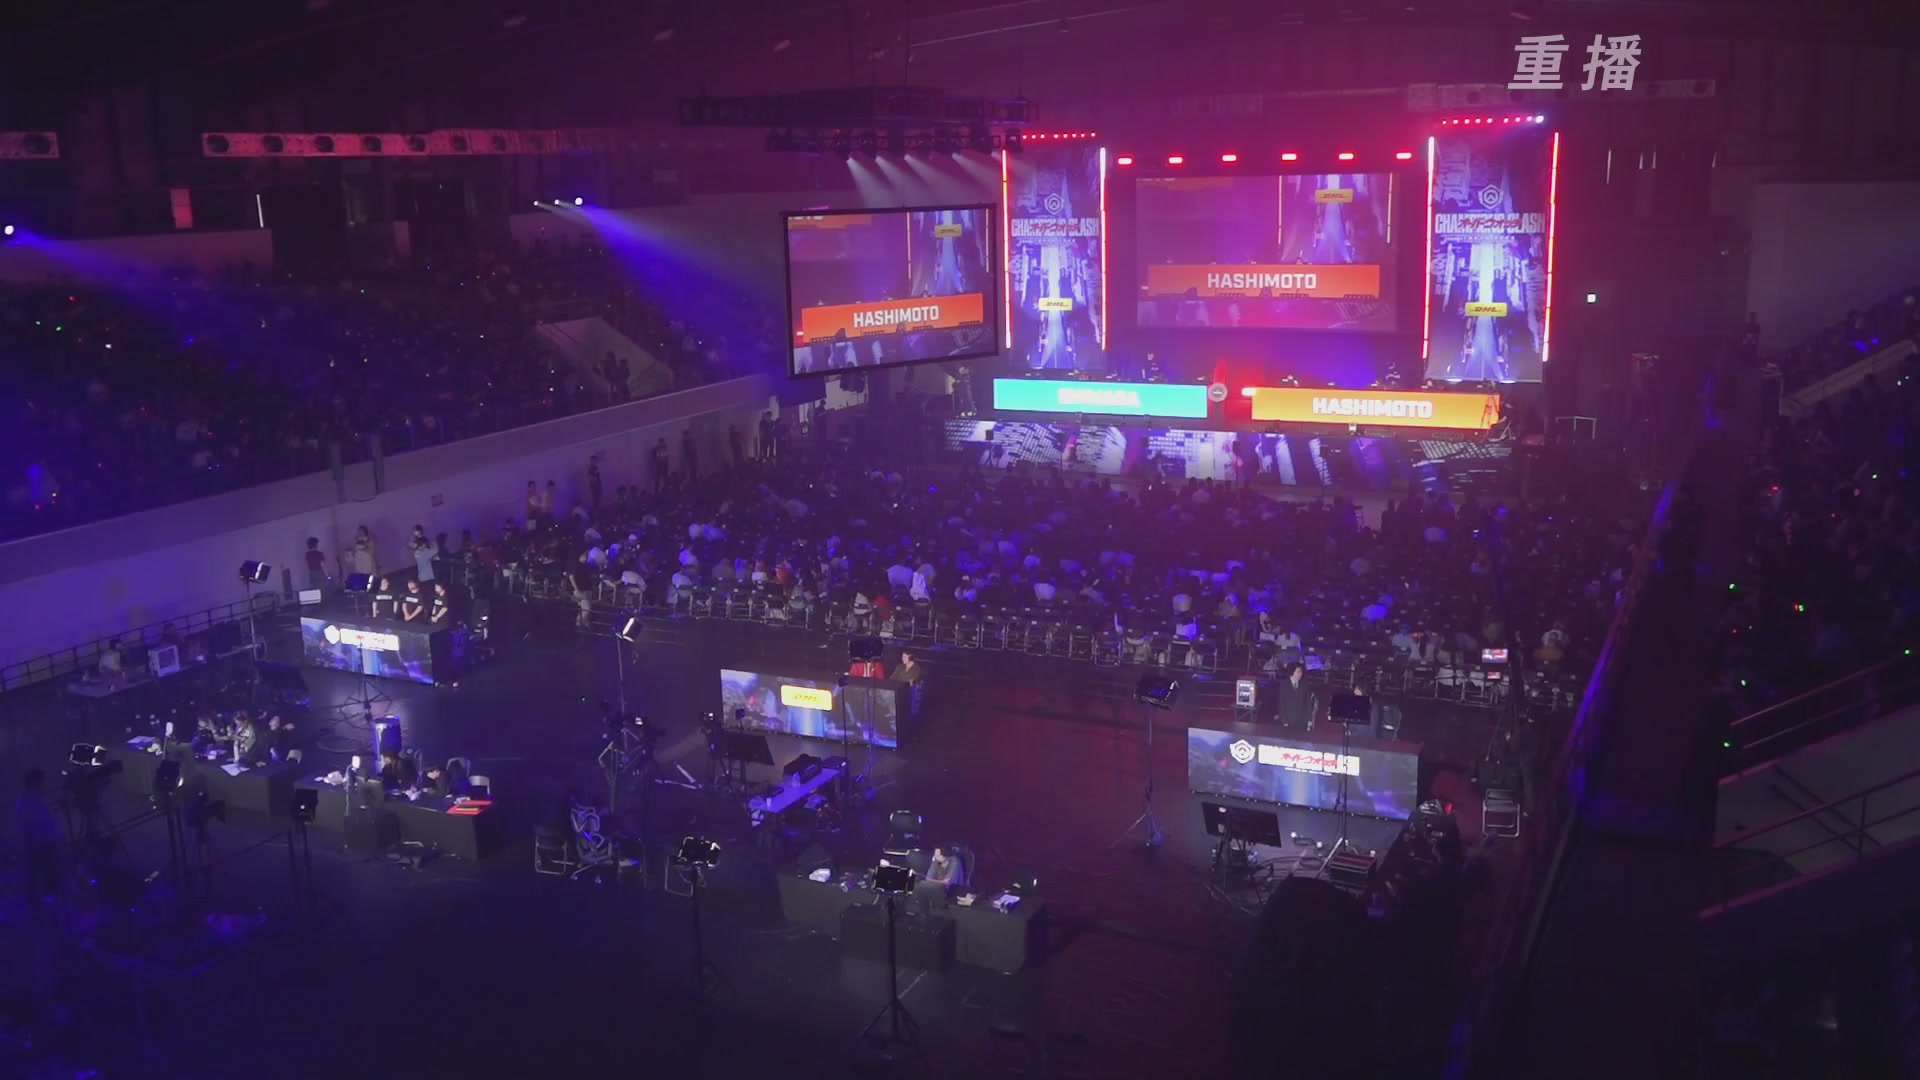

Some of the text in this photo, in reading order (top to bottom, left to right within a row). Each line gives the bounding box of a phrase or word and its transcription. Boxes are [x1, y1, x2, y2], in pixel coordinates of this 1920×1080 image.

[1207, 273, 1317, 289] HASHIMOTO
[853, 305, 939, 328] HASHIMOTO
[1312, 397, 1432, 419] HASHIMOTO
